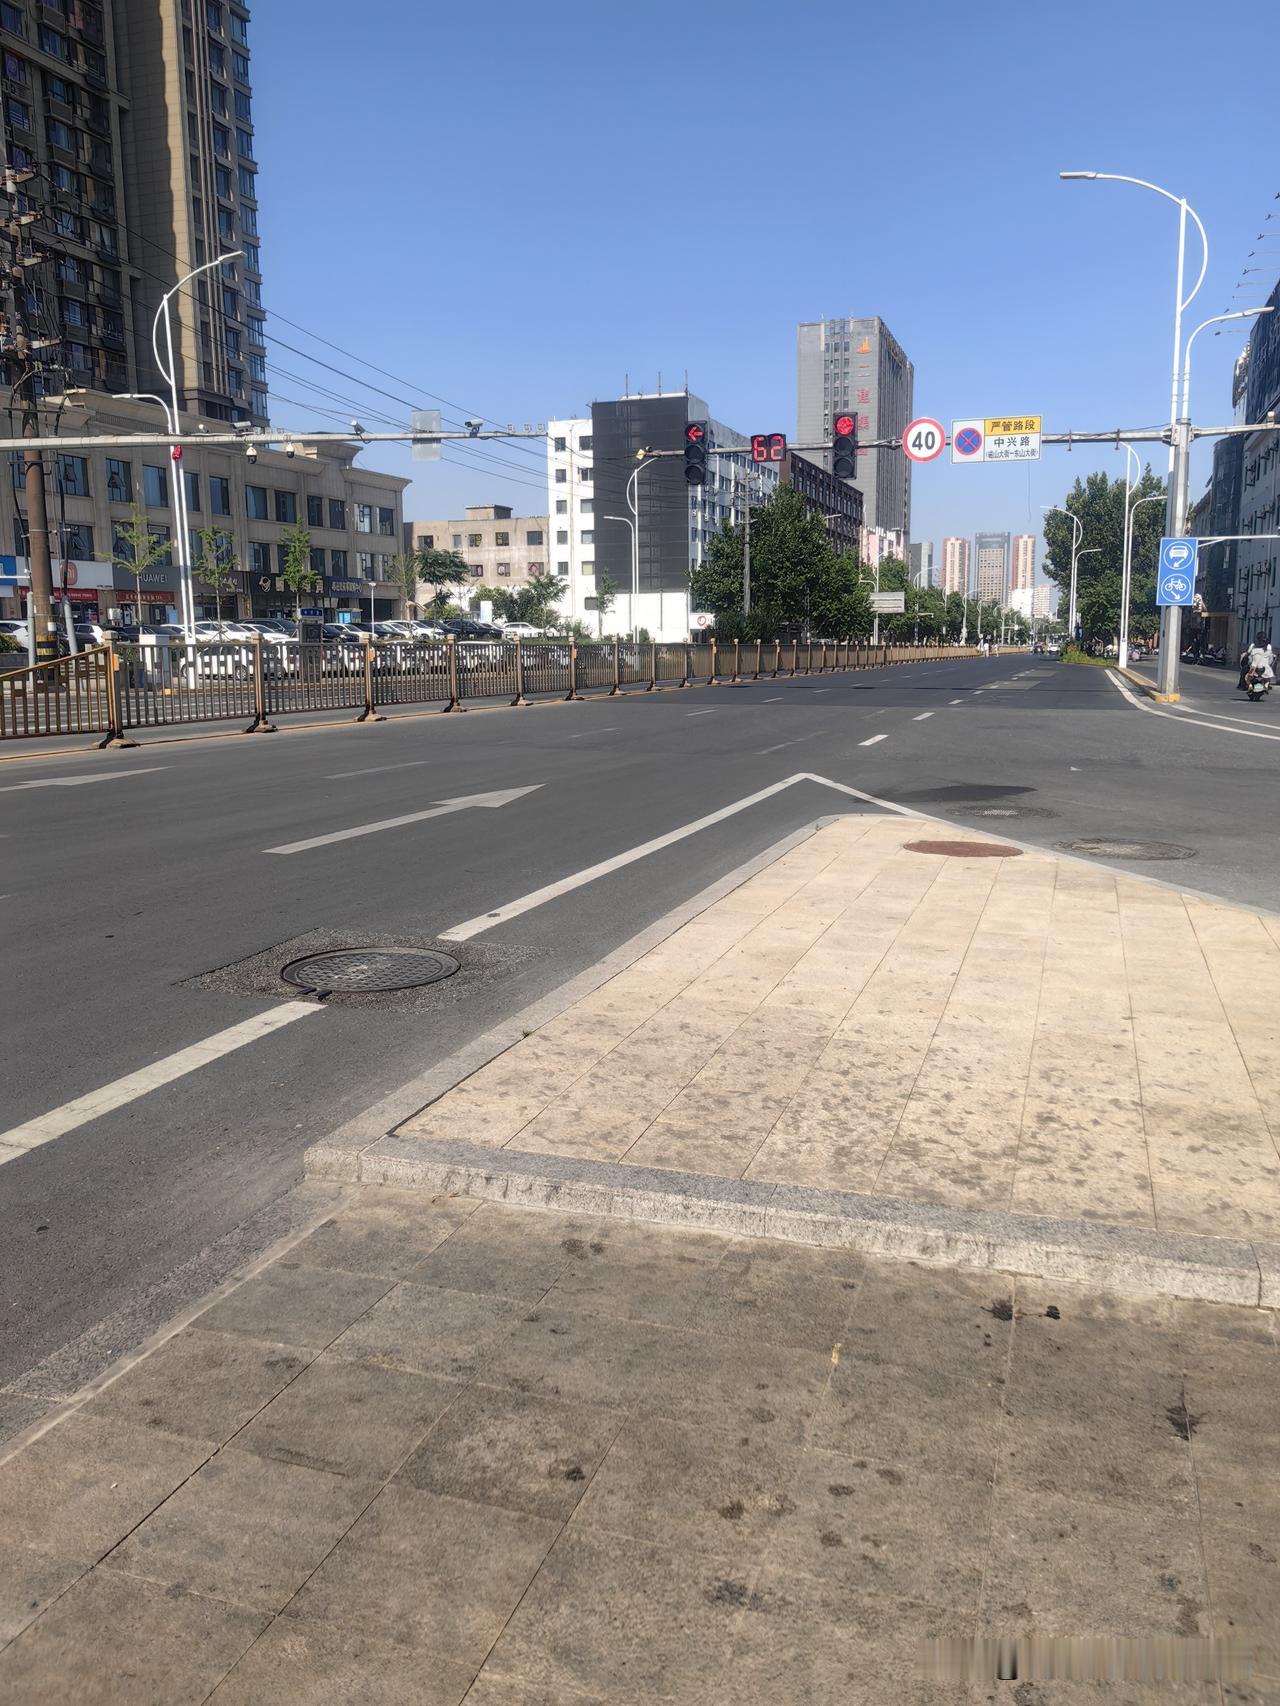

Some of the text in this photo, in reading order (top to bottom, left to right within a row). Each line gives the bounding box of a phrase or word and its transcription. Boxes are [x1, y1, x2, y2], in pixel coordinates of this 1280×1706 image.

[990, 420, 1035, 432] 严管路段
[912, 431, 935, 450] 40
[994, 436, 1030, 447] 中兴路
[754, 436, 784, 461] 62
[137, 573, 168, 583] HUAWEI
